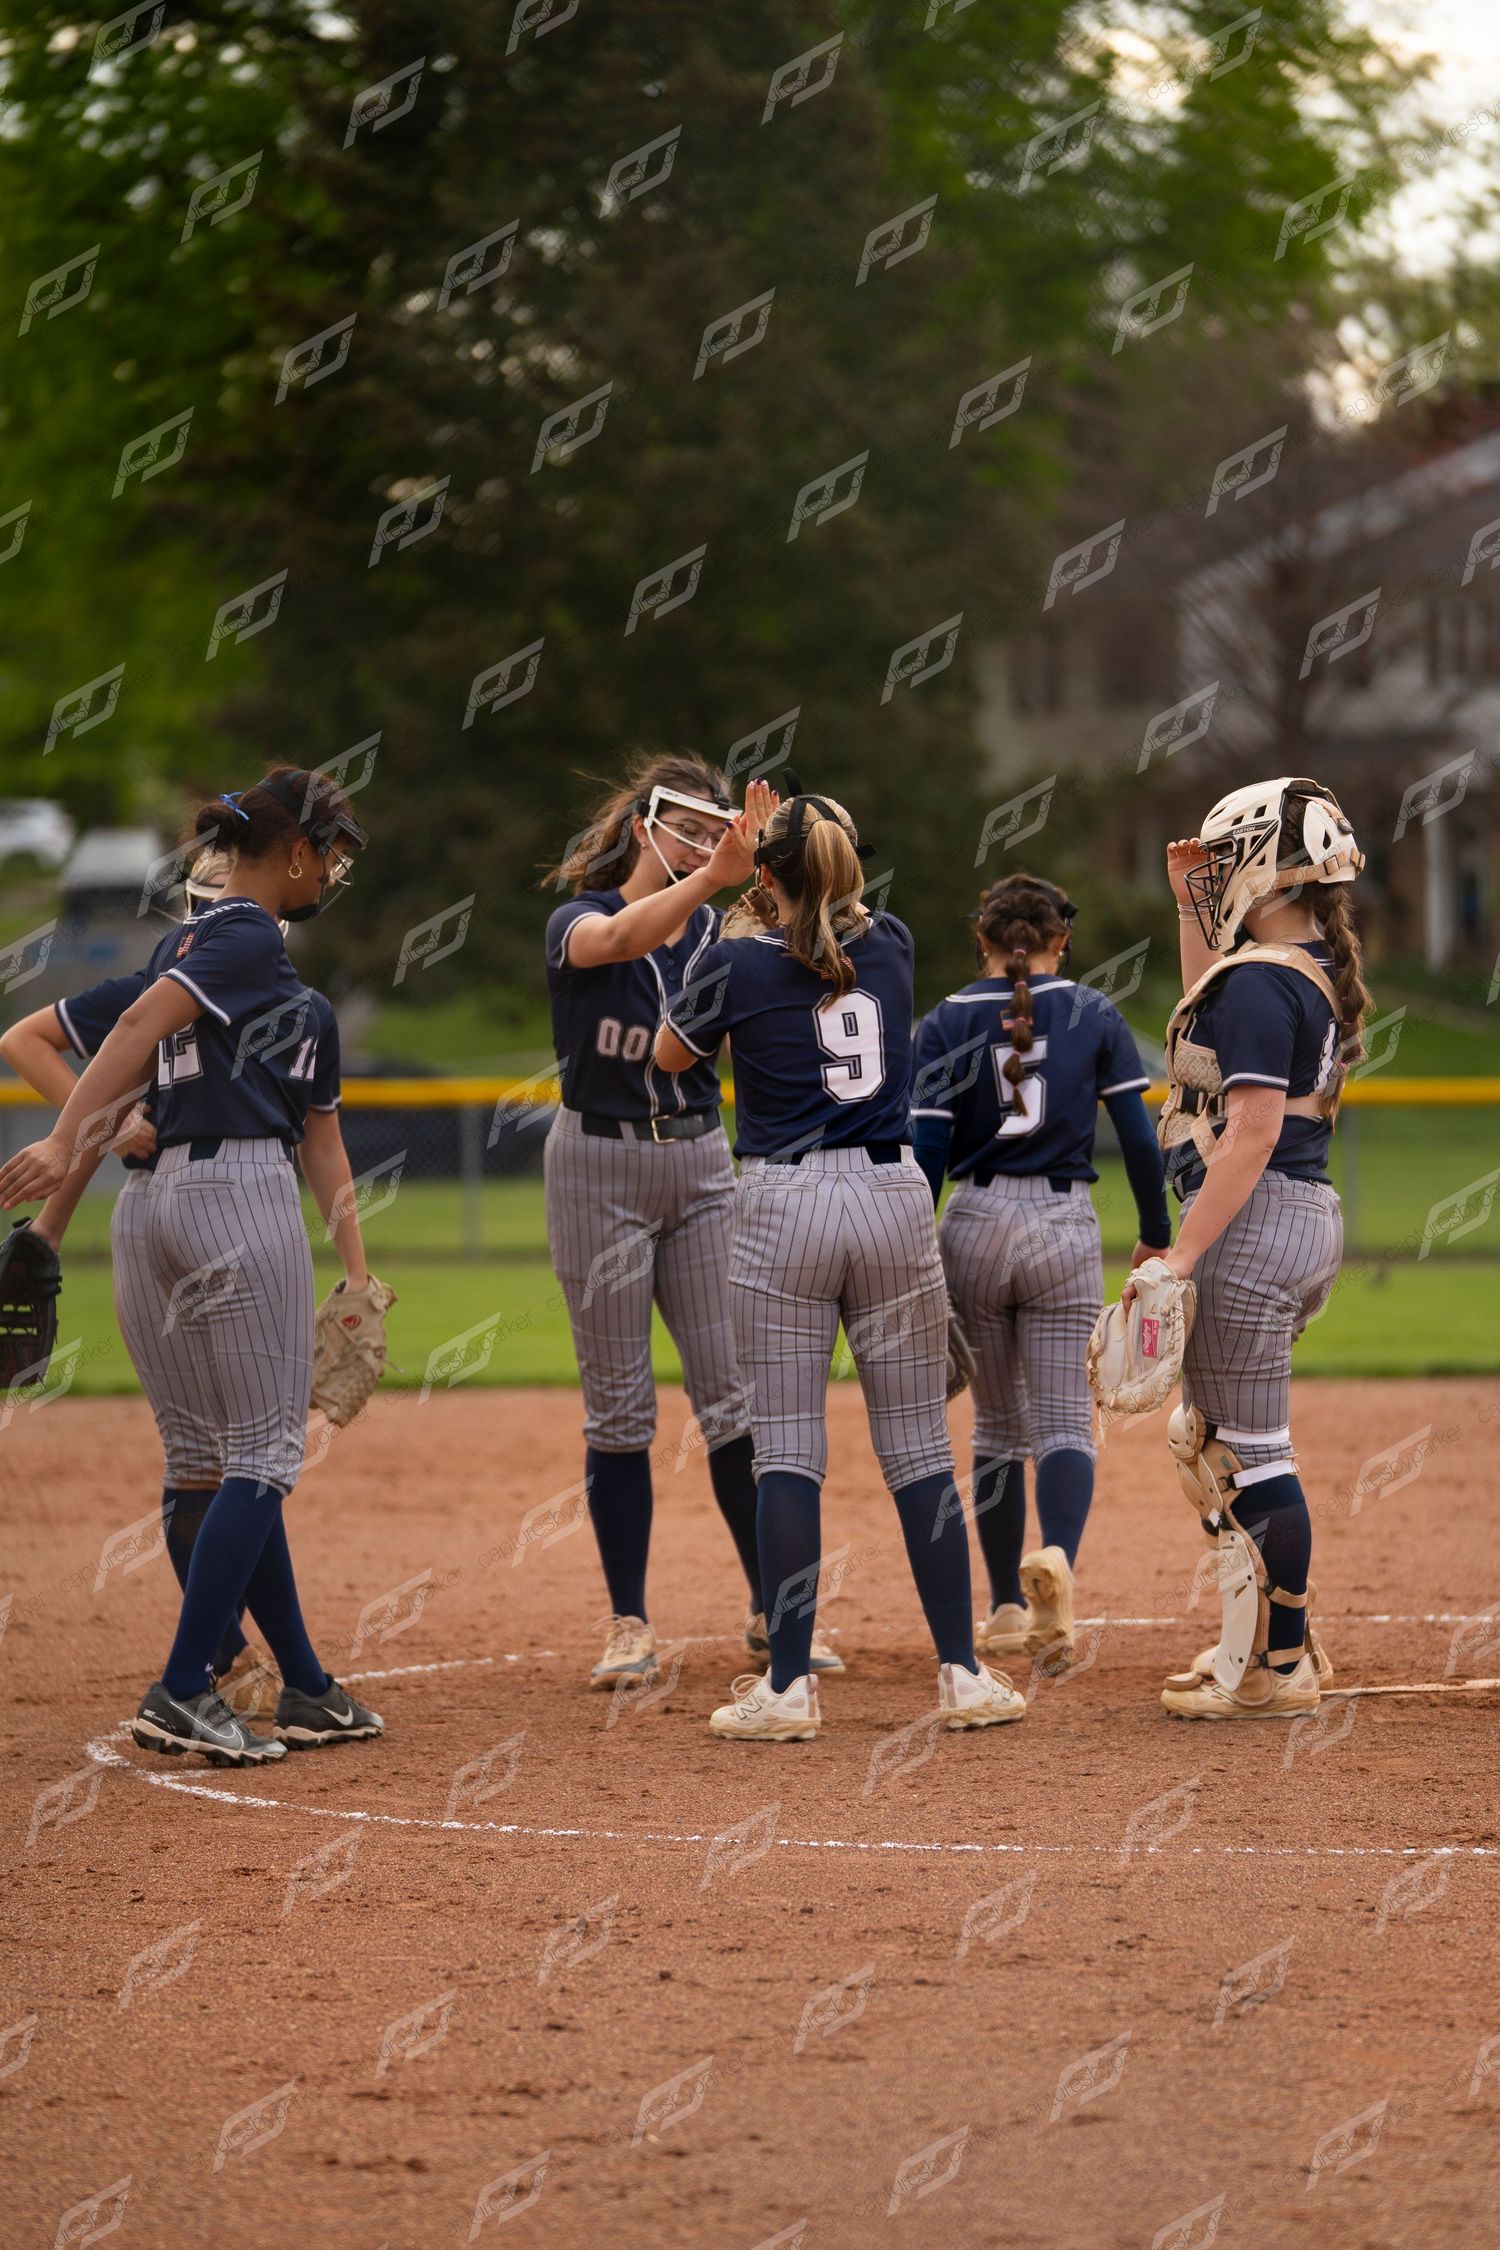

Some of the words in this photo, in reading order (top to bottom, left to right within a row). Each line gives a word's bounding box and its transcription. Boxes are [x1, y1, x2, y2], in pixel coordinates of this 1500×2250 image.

[1232, 825, 1256, 836] EASTON
[597, 1016, 652, 1061] 00
[812, 987, 886, 1105] 9
[989, 1035, 1049, 1140] 5
